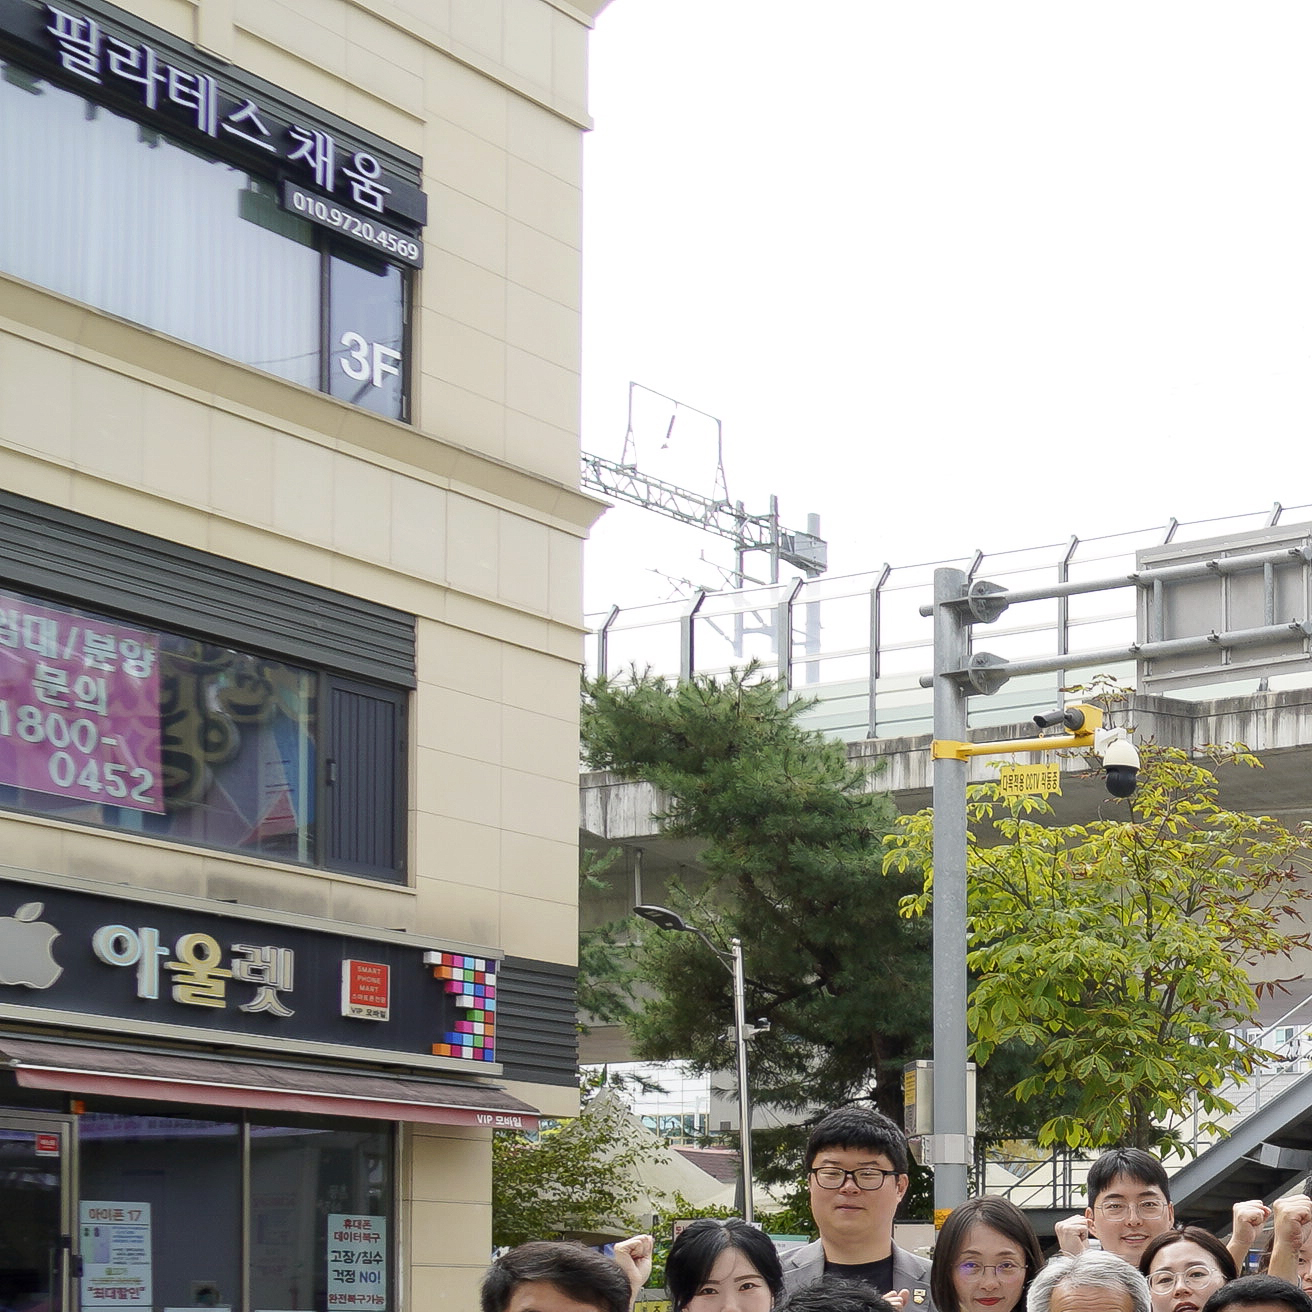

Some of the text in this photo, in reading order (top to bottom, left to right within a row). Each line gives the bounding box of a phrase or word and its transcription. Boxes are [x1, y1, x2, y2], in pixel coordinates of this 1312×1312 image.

[47, 4, 392, 214] 필라테스 채움
[292, 191, 420, 262] 010.9720.4569
[338, 330, 403, 388] 3F
[32, 663, 109, 717] 문의
[48, 750, 155, 804] 0452
[1025, 772, 1041, 791] CCTV
[1041, 771, 1058, 790] 작동중
[91, 922, 296, 1018] 아울렛
[356, 965, 381, 974] SMART
[359, 984, 380, 993] MART
[476, 1113, 522, 1128] VIP 모바일
[127, 1209, 142, 1221] 17
[343, 1218, 373, 1230] 휴대폰
[333, 1231, 382, 1243] 데이터복구
[330, 1250, 384, 1264] 고장/침수
[332, 1270, 381, 1284] 걱정 NO!
[328, 1294, 385, 1305] 완전복구가능
